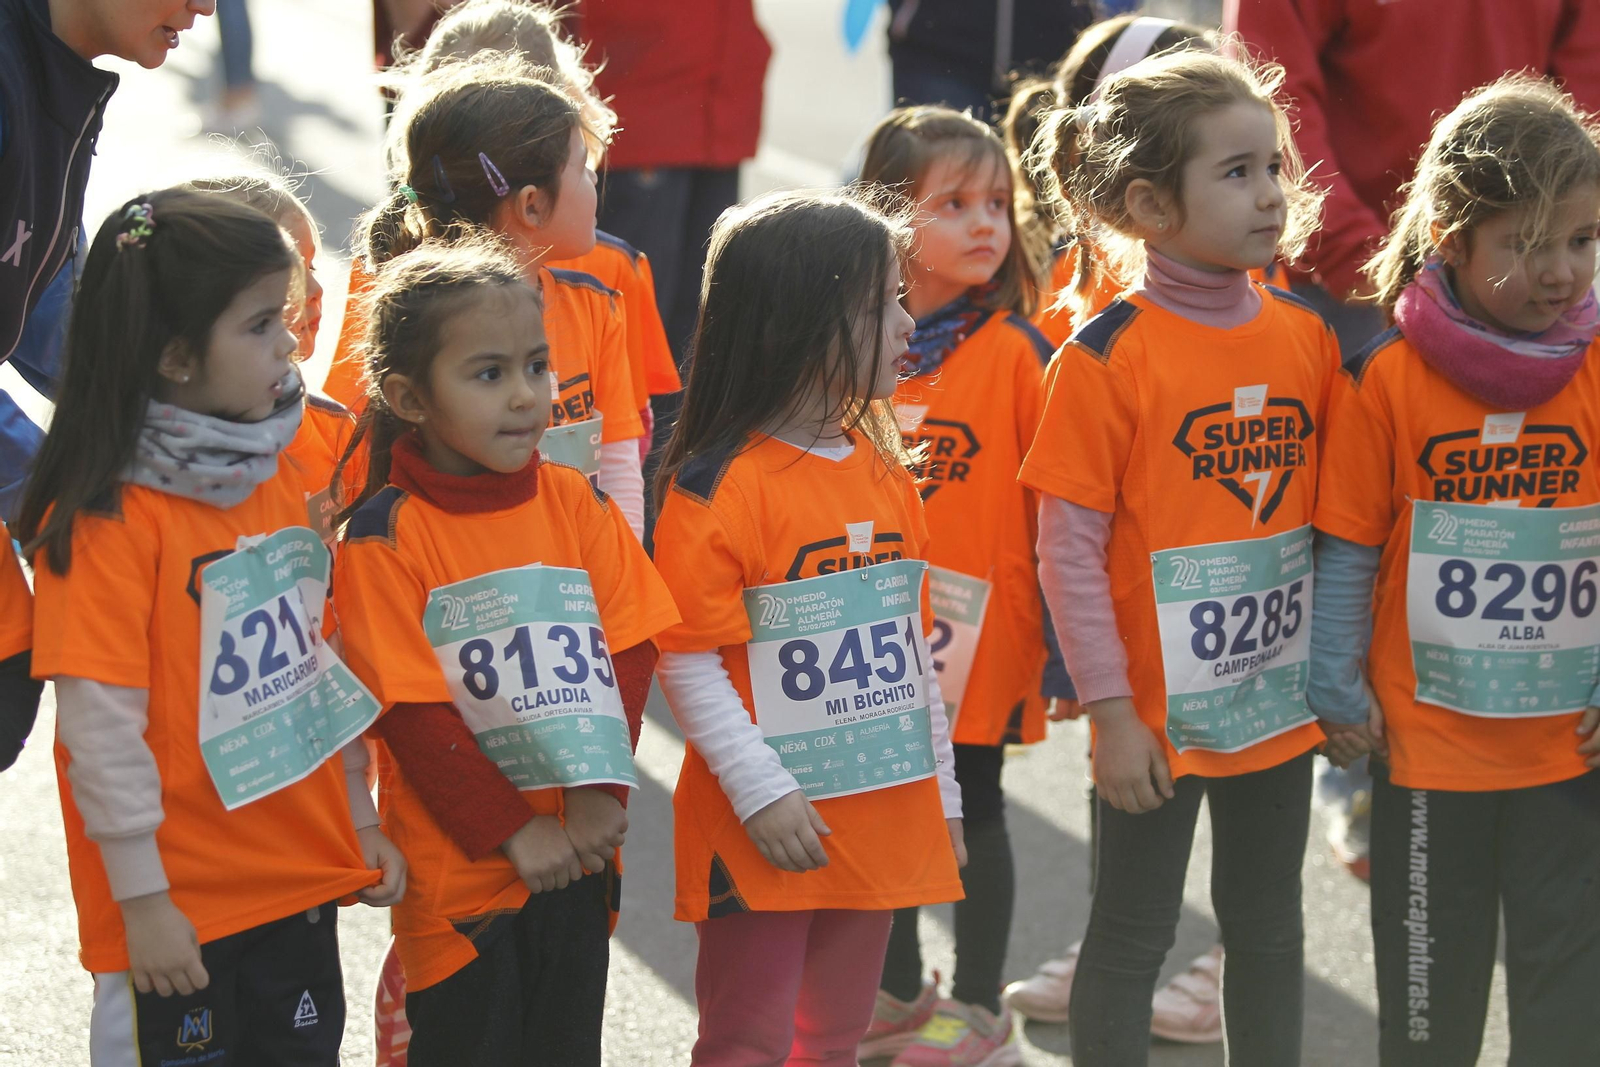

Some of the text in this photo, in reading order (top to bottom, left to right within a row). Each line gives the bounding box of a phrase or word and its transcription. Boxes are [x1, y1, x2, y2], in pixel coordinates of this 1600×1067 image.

[1203, 416, 1297, 450] SUPER
[1193, 442, 1306, 480] RUNNER
[1444, 442, 1564, 475] SUPER
[1434, 469, 1580, 501] RUNNER
[1465, 518, 1497, 529] MEDIO
[1464, 527, 1515, 540] MARATÓN
[1463, 538, 1509, 549] ALMERÍA
[1206, 556, 1238, 566] MEDIO
[1208, 563, 1251, 576] MARATÓN
[1209, 573, 1247, 587] ALMERÍA
[470, 588, 498, 603] MEDIO
[794, 591, 827, 604] MEDIO
[1435, 559, 1598, 622] 8296
[472, 593, 519, 613] MARATÓN
[795, 597, 844, 614] MARATÓN
[475, 606, 515, 624] ALMERÍA
[798, 609, 842, 625] ALMERÍA
[1189, 580, 1303, 661] 8285
[798, 620, 836, 632] 03/02/2019
[1499, 626, 1545, 640] ALBA
[458, 625, 614, 701] 8135
[778, 616, 923, 701] 8451
[511, 688, 591, 713] CLAUDIA
[825, 682, 916, 716] MI BICHITO
[1182, 700, 1208, 712] NEXA
[516, 713, 541, 724] CLAUDIA
[544, 707, 573, 717] ORTEGA
[835, 702, 915, 725] ELENA MORAGA RODRÍGUEZ
[219, 735, 249, 755] NEXA
[253, 719, 276, 738] CDX
[533, 722, 567, 736] ALMERÍA
[859, 723, 891, 735] ALMERÍA
[486, 736, 508, 749] NEXA
[780, 734, 836, 754] NEXA CDX
[1403, 791, 1435, 1041] www.mercapinturas.es
